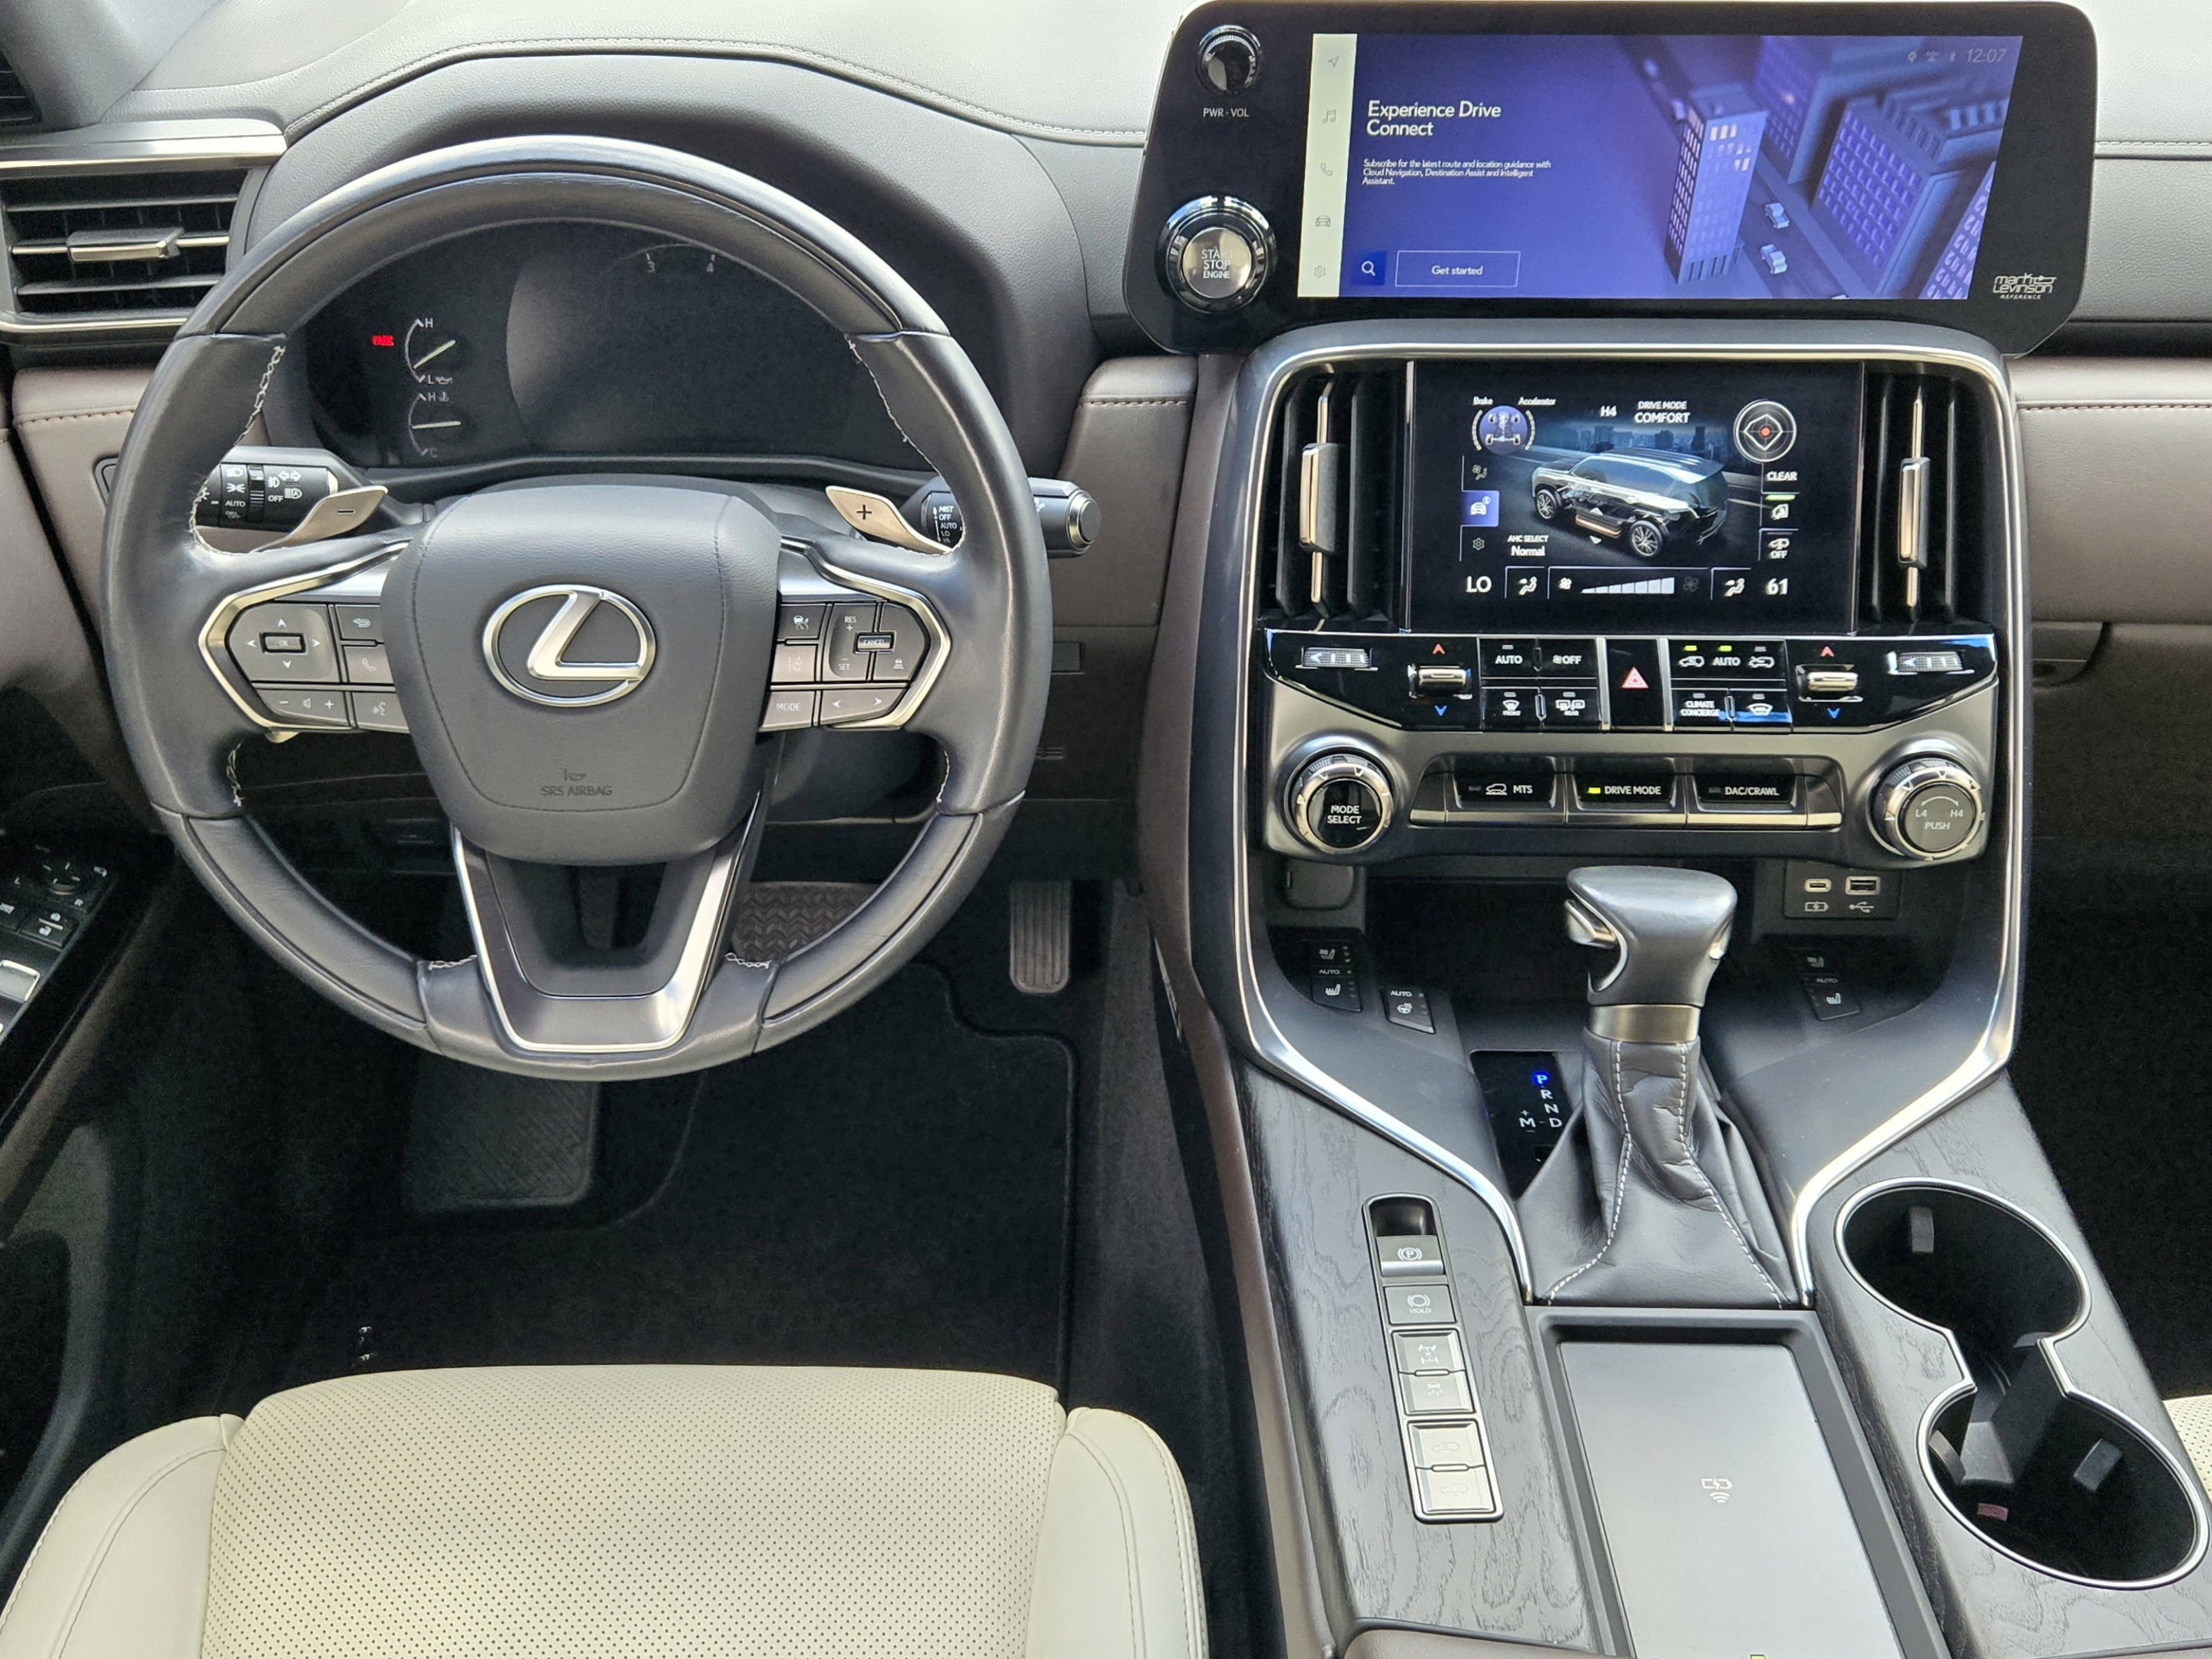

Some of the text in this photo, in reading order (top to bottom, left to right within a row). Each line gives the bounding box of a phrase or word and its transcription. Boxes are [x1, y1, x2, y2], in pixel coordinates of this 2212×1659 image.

[1968, 48, 2007, 63] 12:07
[1203, 108, 1250, 117] PWR VOL
[1367, 100, 1502, 121] Experience Drive
[1366, 119, 1434, 136] Connect
[1363, 158, 1396, 167] Subscribe
[1398, 158, 1409, 167] for
[1409, 159, 1421, 167] the
[1462, 159, 1475, 168] and
[1476, 160, 1502, 168] location
[1504, 160, 1535, 170] guidance
[1535, 160, 1551, 168] with
[1363, 167, 1384, 176] Cloud
[1386, 168, 1424, 178] Navigation,
[1426, 168, 1464, 177] Destination
[1500, 169, 1534, 178] Intelligent
[1204, 260, 1230, 270] STOP
[1432, 265, 1484, 275] Get started
[1203, 270, 1230, 280] ENGINE
[426, 318, 433, 328] H
[1473, 396, 1493, 406] Brake
[1637, 401, 1687, 410] DRIVE MODE
[1600, 406, 1618, 417] H4
[1634, 412, 1690, 423] COMFORT
[1767, 472, 1797, 481] CLEAR
[1510, 545, 1545, 556] Normal
[1770, 550, 1788, 559] OFF
[1465, 576, 1492, 593] LO
[1767, 578, 1789, 594] 61
[1495, 654, 1523, 664] AUTO
[1712, 657, 1741, 667] AUTO
[776, 702, 802, 711] MODE
[1680, 708, 1720, 717] CONCIERGE
[541, 785, 613, 796] SRS AIRBAG
[1513, 785, 1533, 794] MTS
[1604, 786, 1661, 795] DRIVE MODE
[1725, 786, 1780, 796] DAC/CRAWL
[1330, 805, 1359, 814] MODE
[1916, 809, 1963, 817] L4 H4
[1327, 815, 1363, 824] SELECT
[1536, 1075, 1548, 1084] P
[1540, 1089, 1553, 1100] R
[1544, 1103, 1559, 1114] N
[1548, 1118, 1563, 1128] D
